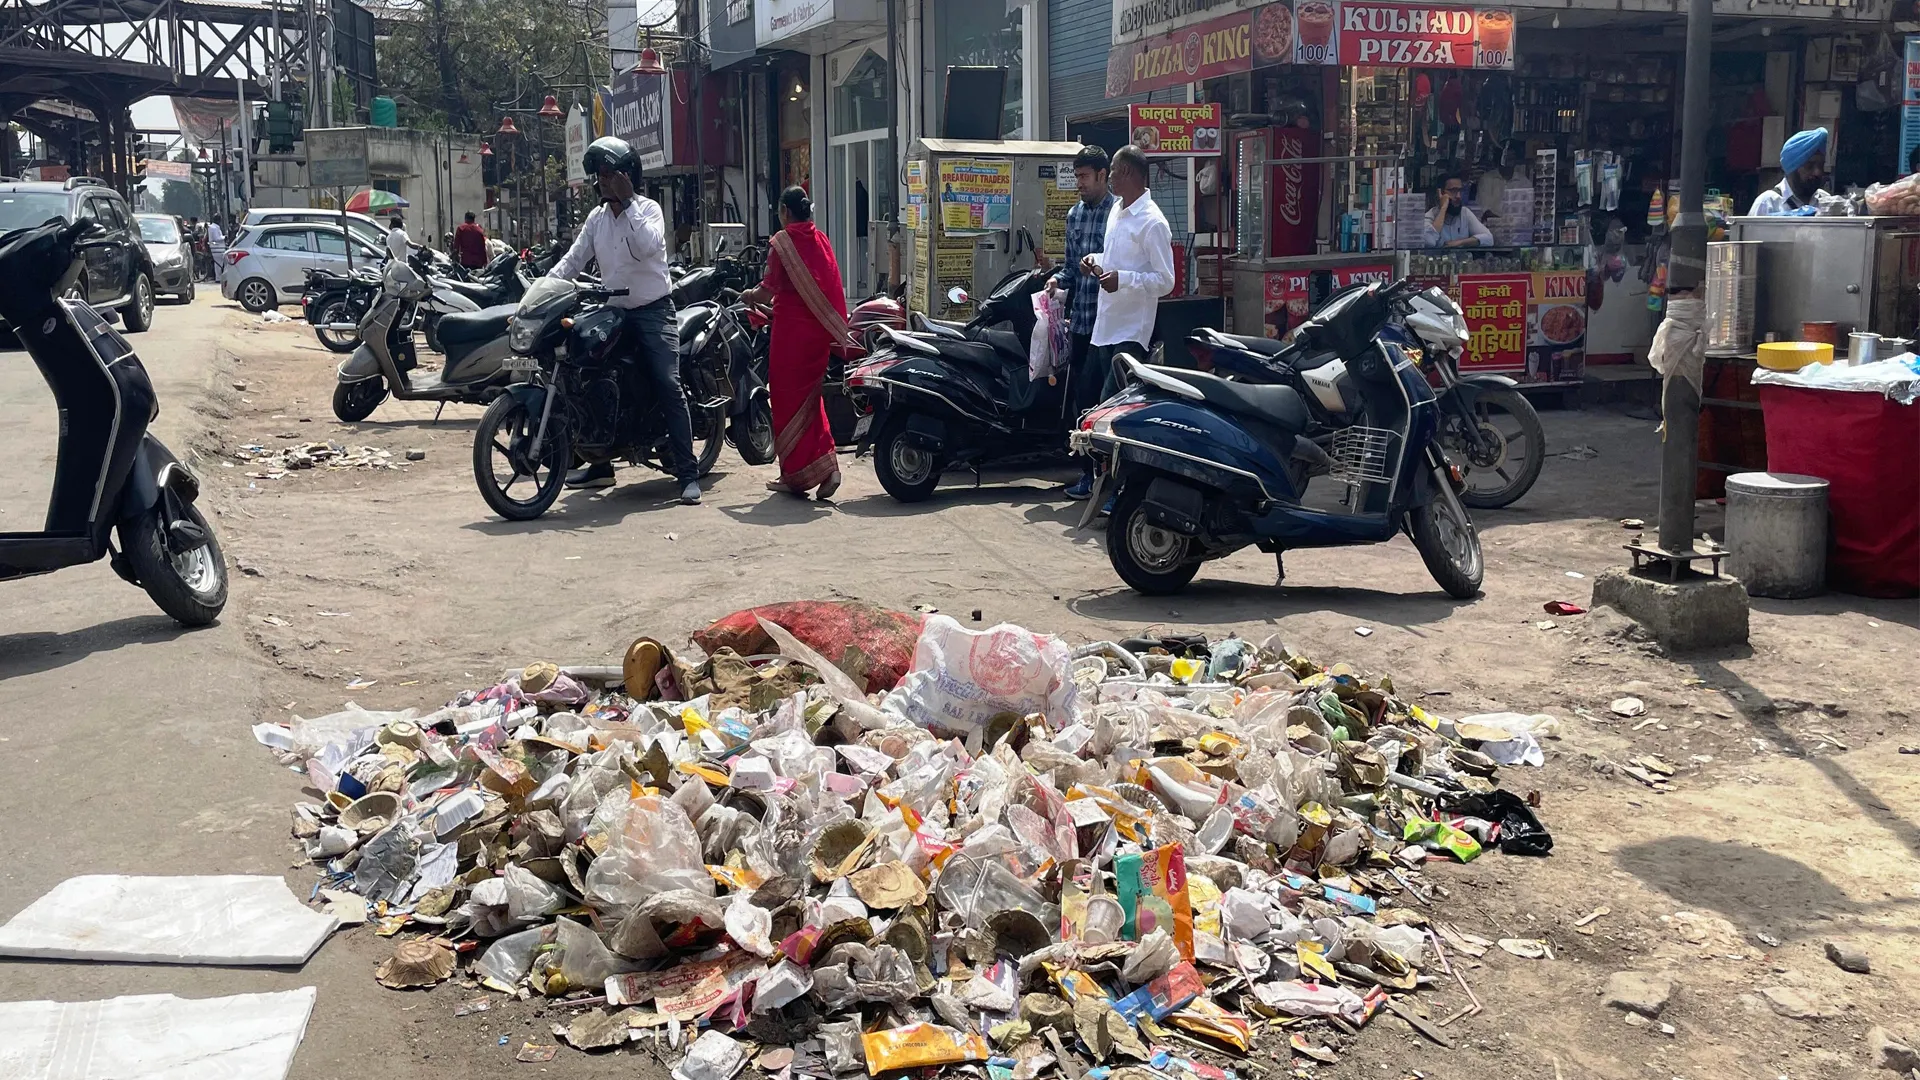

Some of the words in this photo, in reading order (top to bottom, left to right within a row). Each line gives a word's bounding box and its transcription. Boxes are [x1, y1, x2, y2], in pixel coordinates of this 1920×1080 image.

[1343, 6, 1473, 35] KULHAD
[1133, 42, 1184, 82] PIZZA
[1202, 24, 1250, 66] KING
[1298, 44, 1335, 61] 100/-
[1359, 38, 1456, 64] PIZZA
[1478, 50, 1513, 66] 100/-
[1138, 107, 1177, 124] फालूदा
[1160, 135, 1192, 151] लस्सी
[942, 173, 978, 183] BREAKOUT
[980, 174, 1010, 184] TRADERS
[1280, 134, 1303, 225] Coca-Cola
[1289, 275, 1341, 292] PIA
[1350, 271, 1389, 285] KING
[1544, 275, 1586, 298] KING
[1501, 300, 1524, 318] की
[1312, 378, 1331, 388] YAMAHA
